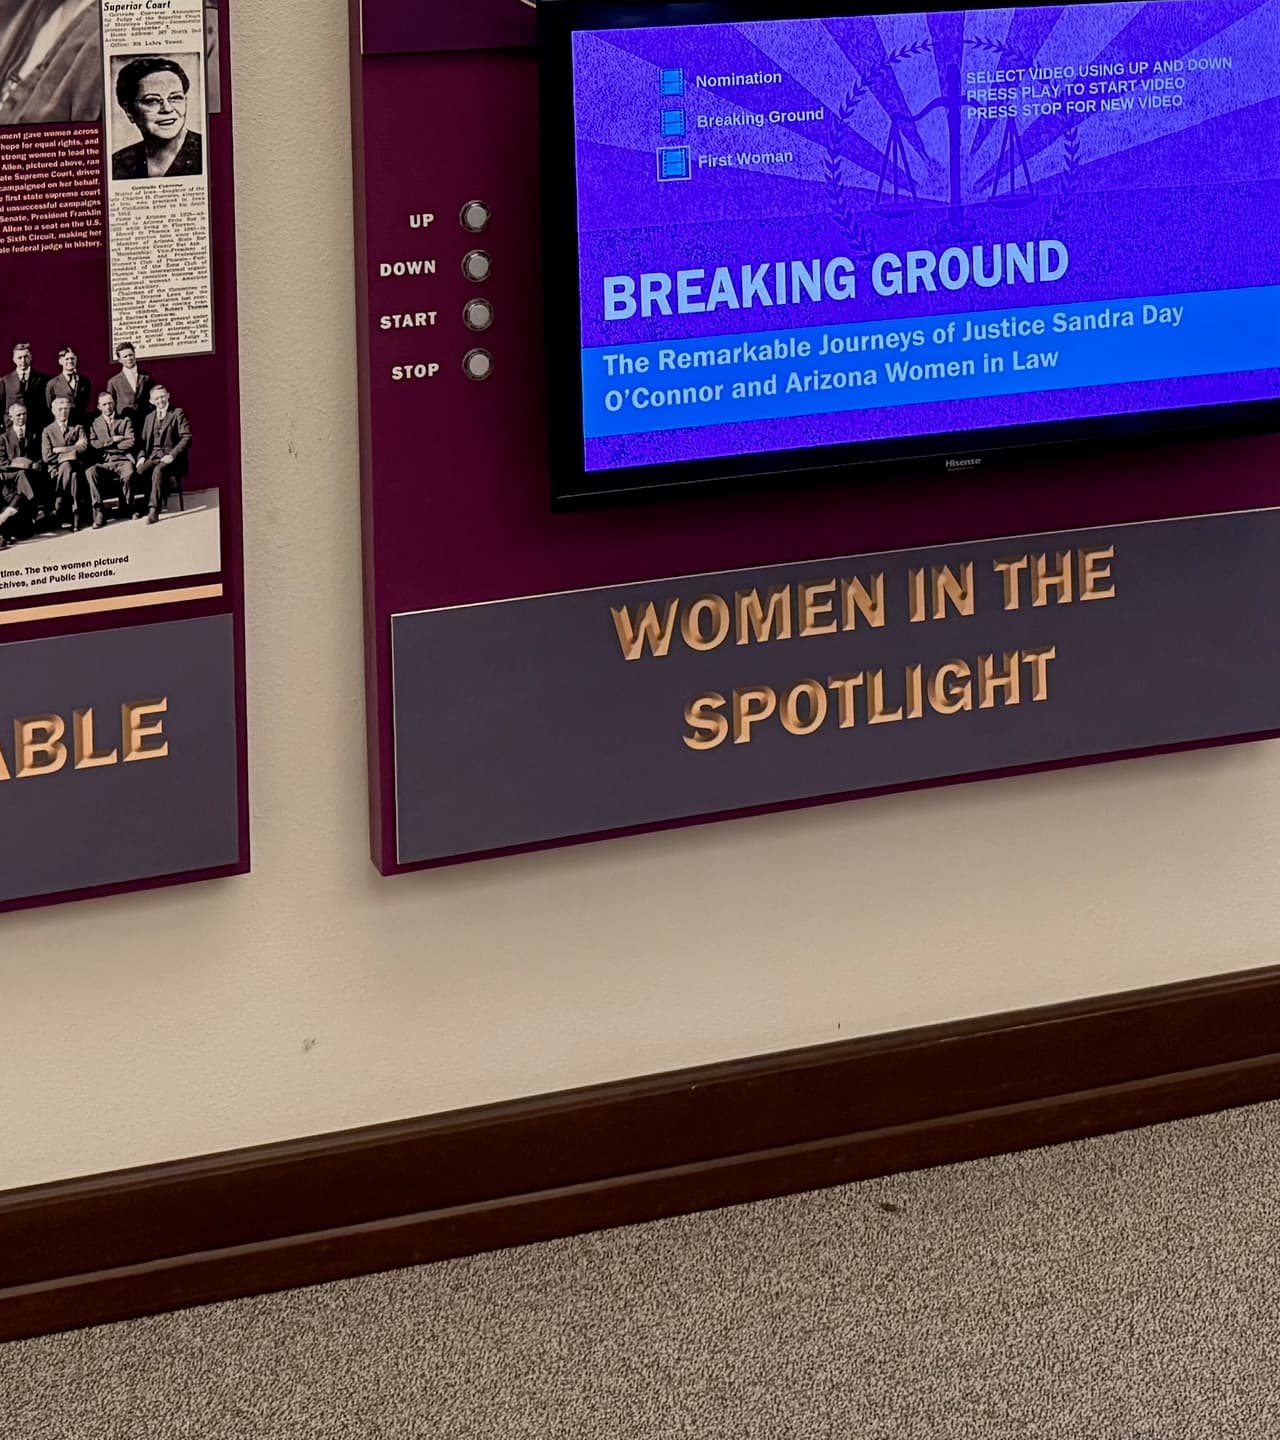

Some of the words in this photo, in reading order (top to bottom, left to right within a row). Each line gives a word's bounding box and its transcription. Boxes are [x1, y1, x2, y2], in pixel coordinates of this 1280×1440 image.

[103, 1, 143, 12] Superior
[145, 0, 171, 10] Court
[696, 70, 782, 88] Nomination
[966, 68, 1025, 84] SELECT
[1028, 66, 1074, 80] VIDEO
[1079, 63, 1124, 77] USING
[1129, 61, 1148, 74] UP
[1153, 59, 1183, 73] AND
[1188, 57, 1232, 70] DOWN
[967, 87, 1017, 102] PRESS
[1022, 84, 1060, 98] PLAY
[1064, 83, 1084, 95] TO
[1089, 79, 1137, 94] START
[1140, 77, 1185, 91] VIDEO
[697, 111, 764, 130] Breaking
[769, 107, 823, 123] Ground
[698, 153, 733, 168] First
[736, 151, 793, 166] Woman
[409, 213, 435, 229] UP
[379, 259, 437, 277] DOWN
[603, 256, 855, 321] BREAKING
[871, 239, 1068, 296] GROUND
[379, 311, 438, 330] START
[602, 353, 649, 376] The
[658, 337, 811, 371] Remarkable
[818, 329, 925, 355] Journeys
[932, 321, 955, 344] of
[962, 316, 1045, 342] Justice
[1052, 308, 1134, 333] Sandra
[1142, 304, 1183, 327] Day
[391, 363, 440, 381] STOP
[604, 384, 723, 411] O’Connor
[731, 373, 776, 399] and
[785, 369, 877, 393] Arizona
[884, 359, 975, 383] Women
[983, 352, 1004, 373] in
[1012, 350, 1058, 371] Law
[609, 572, 886, 661] WOMEN
[908, 560, 975, 623] IN
[993, 544, 1116, 612] THE
[682, 645, 1056, 751] SPOTLIGHT
